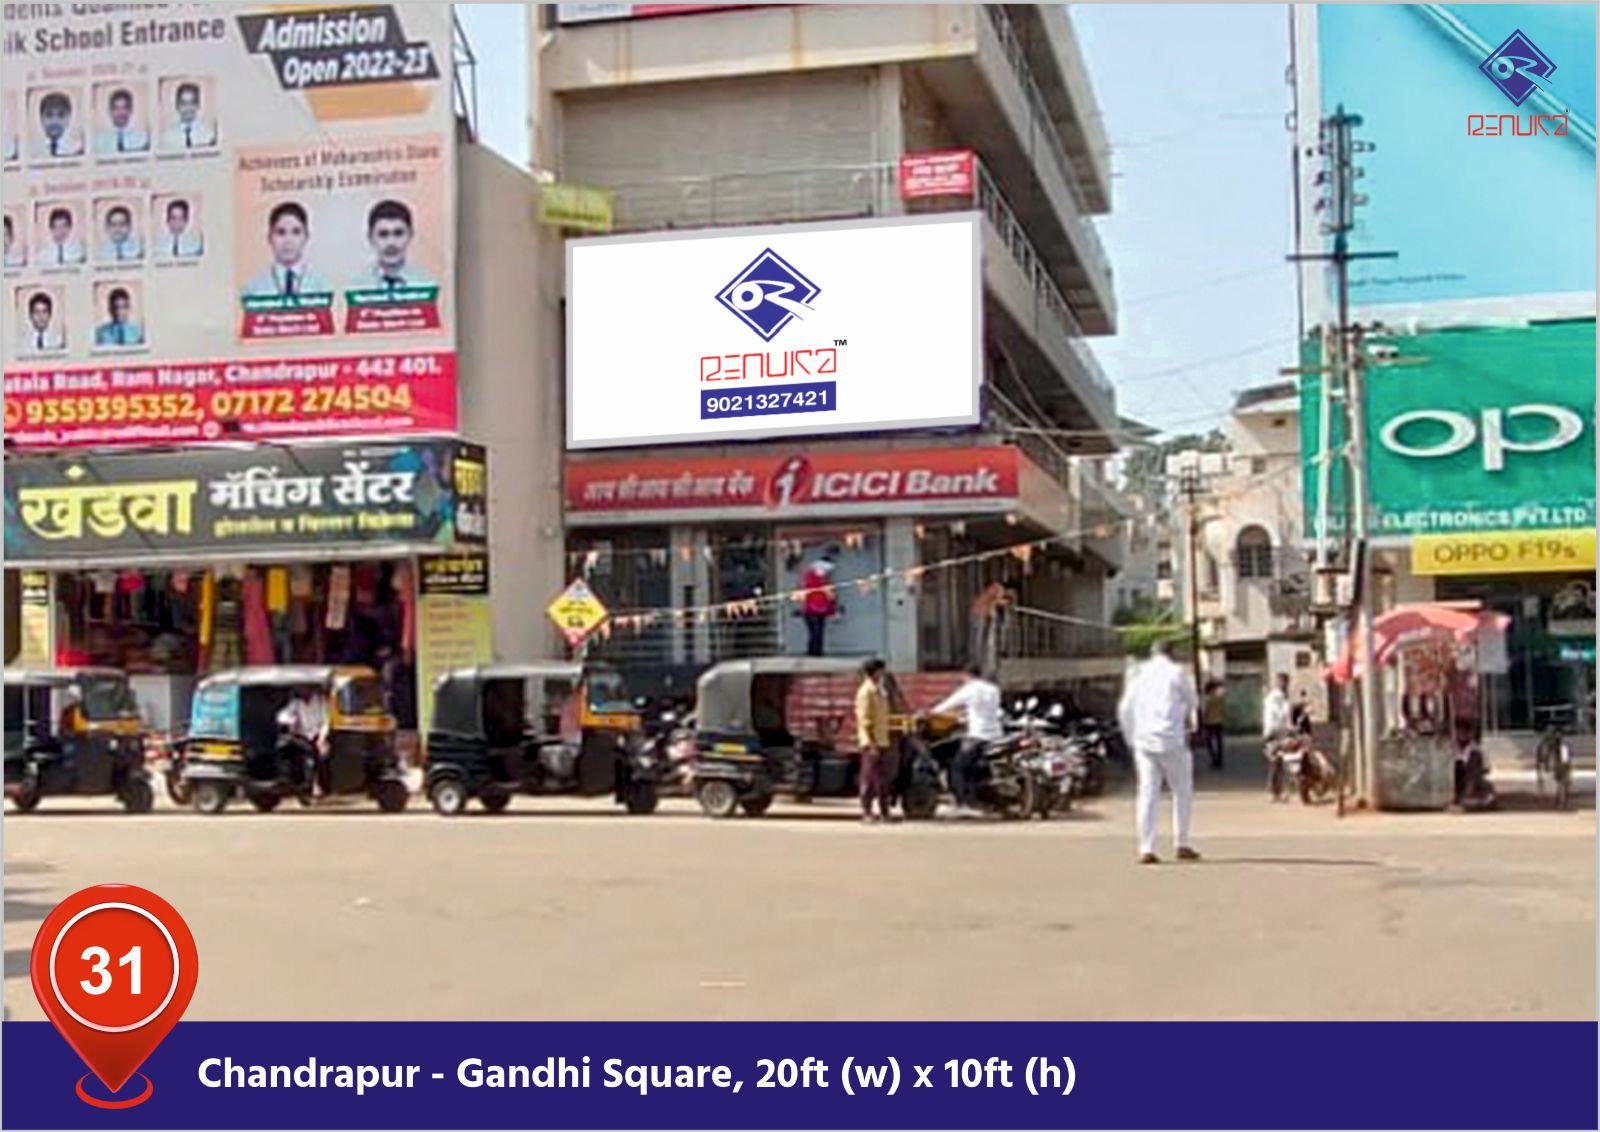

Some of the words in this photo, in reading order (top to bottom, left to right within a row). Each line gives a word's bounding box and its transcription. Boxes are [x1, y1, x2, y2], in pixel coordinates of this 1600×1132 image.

[34, 22, 112, 52] School
[120, 18, 225, 46] Entrance
[257, 12, 388, 50] Admission
[283, 57, 340, 86] Open
[341, 47, 430, 79] 2022-23
[833, 339, 848, 347] TM
[53, 372, 108, 391] Road,
[225, 361, 340, 383] Chandrapur
[26, 393, 205, 423] 9359395352,
[211, 388, 295, 416] 07172
[301, 384, 411, 412] 274504
[706, 390, 828, 413] 9021327421
[811, 472, 901, 498] ICICI
[905, 467, 998, 495] Bank
[19, 464, 198, 540] खंडवा
[1433, 543, 1509, 564] OPPO
[1518, 540, 1577, 560] F19s
